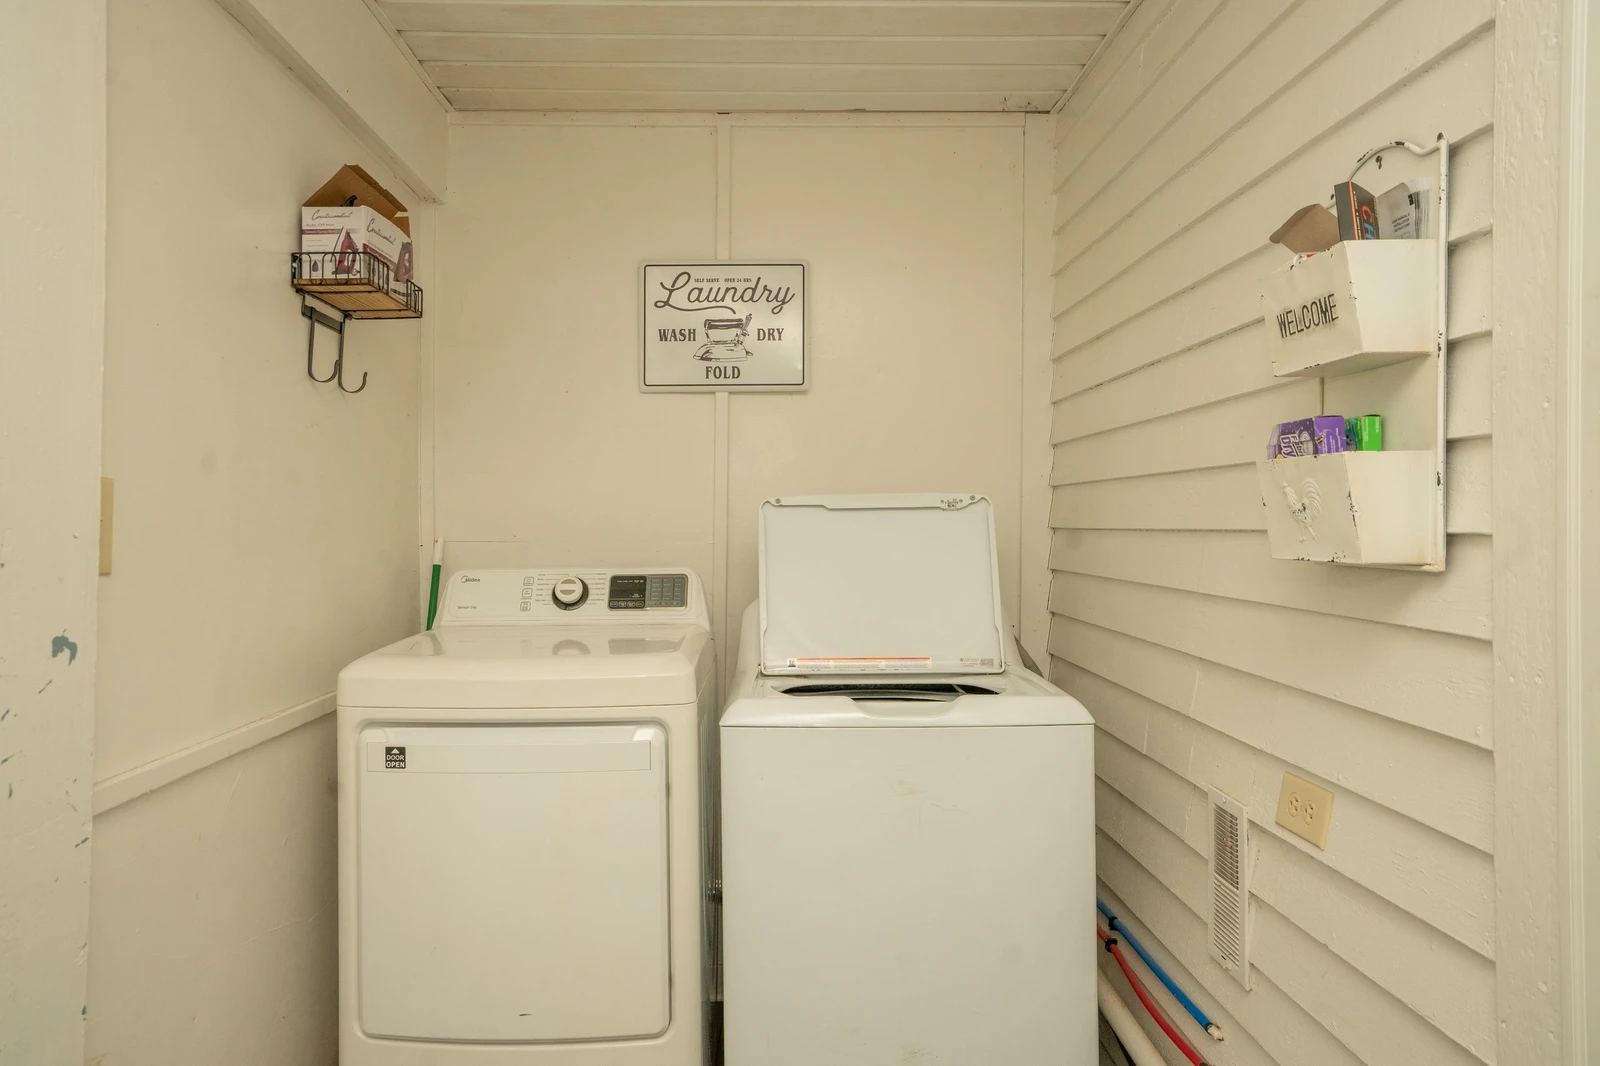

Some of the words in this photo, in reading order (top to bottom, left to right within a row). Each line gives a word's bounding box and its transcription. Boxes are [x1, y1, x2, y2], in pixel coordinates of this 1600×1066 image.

[654, 271, 796, 315] Laundry
[1276, 293, 1339, 339] WELCOME
[658, 328, 697, 342] WASH
[756, 328, 785, 342] DRY
[705, 365, 741, 380] FOLD
